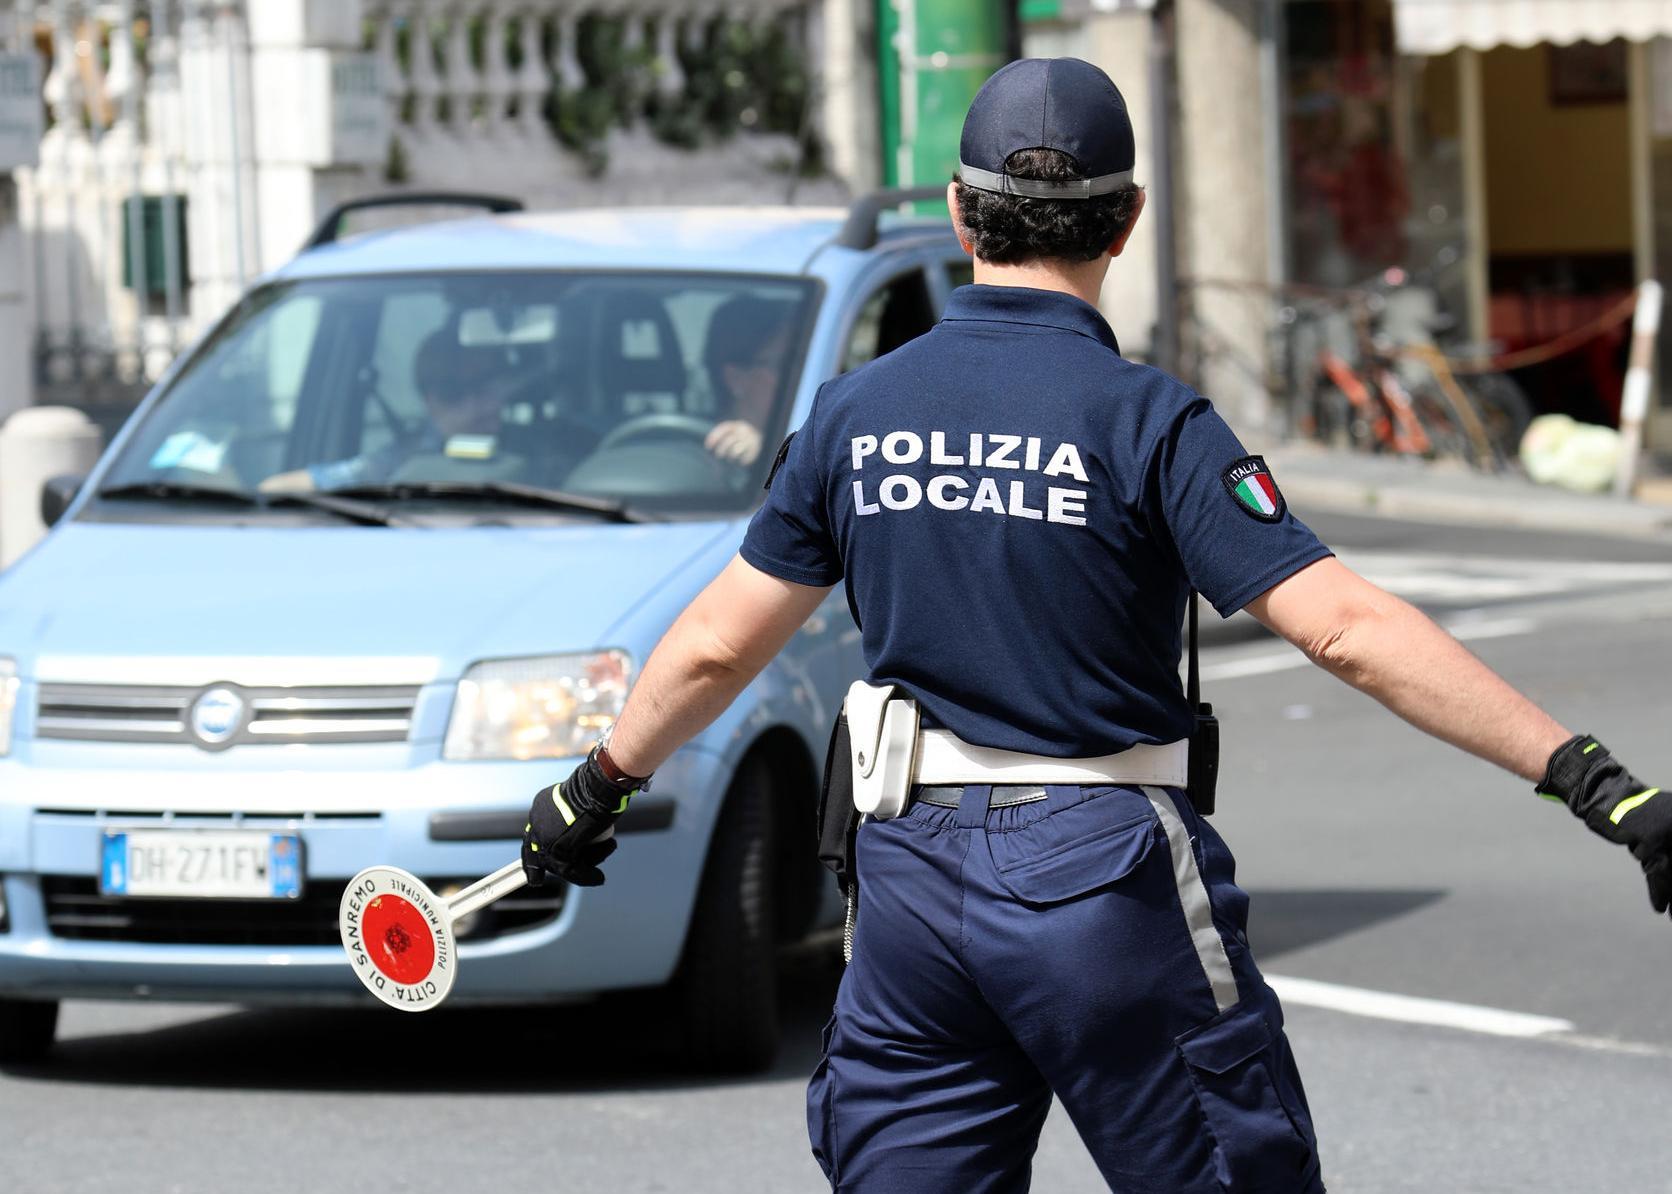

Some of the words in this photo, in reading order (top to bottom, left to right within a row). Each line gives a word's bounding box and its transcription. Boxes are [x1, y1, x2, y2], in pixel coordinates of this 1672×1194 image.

[851, 430, 1090, 482] POLIZIA
[1229, 462, 1260, 482] ITALIA
[852, 474, 1088, 526] LOCALE
[346, 879, 376, 966] SANREMO
[391, 879, 439, 925] MUNICIPALE
[435, 928, 447, 970] POLIZIA
[369, 970, 386, 990] DI
